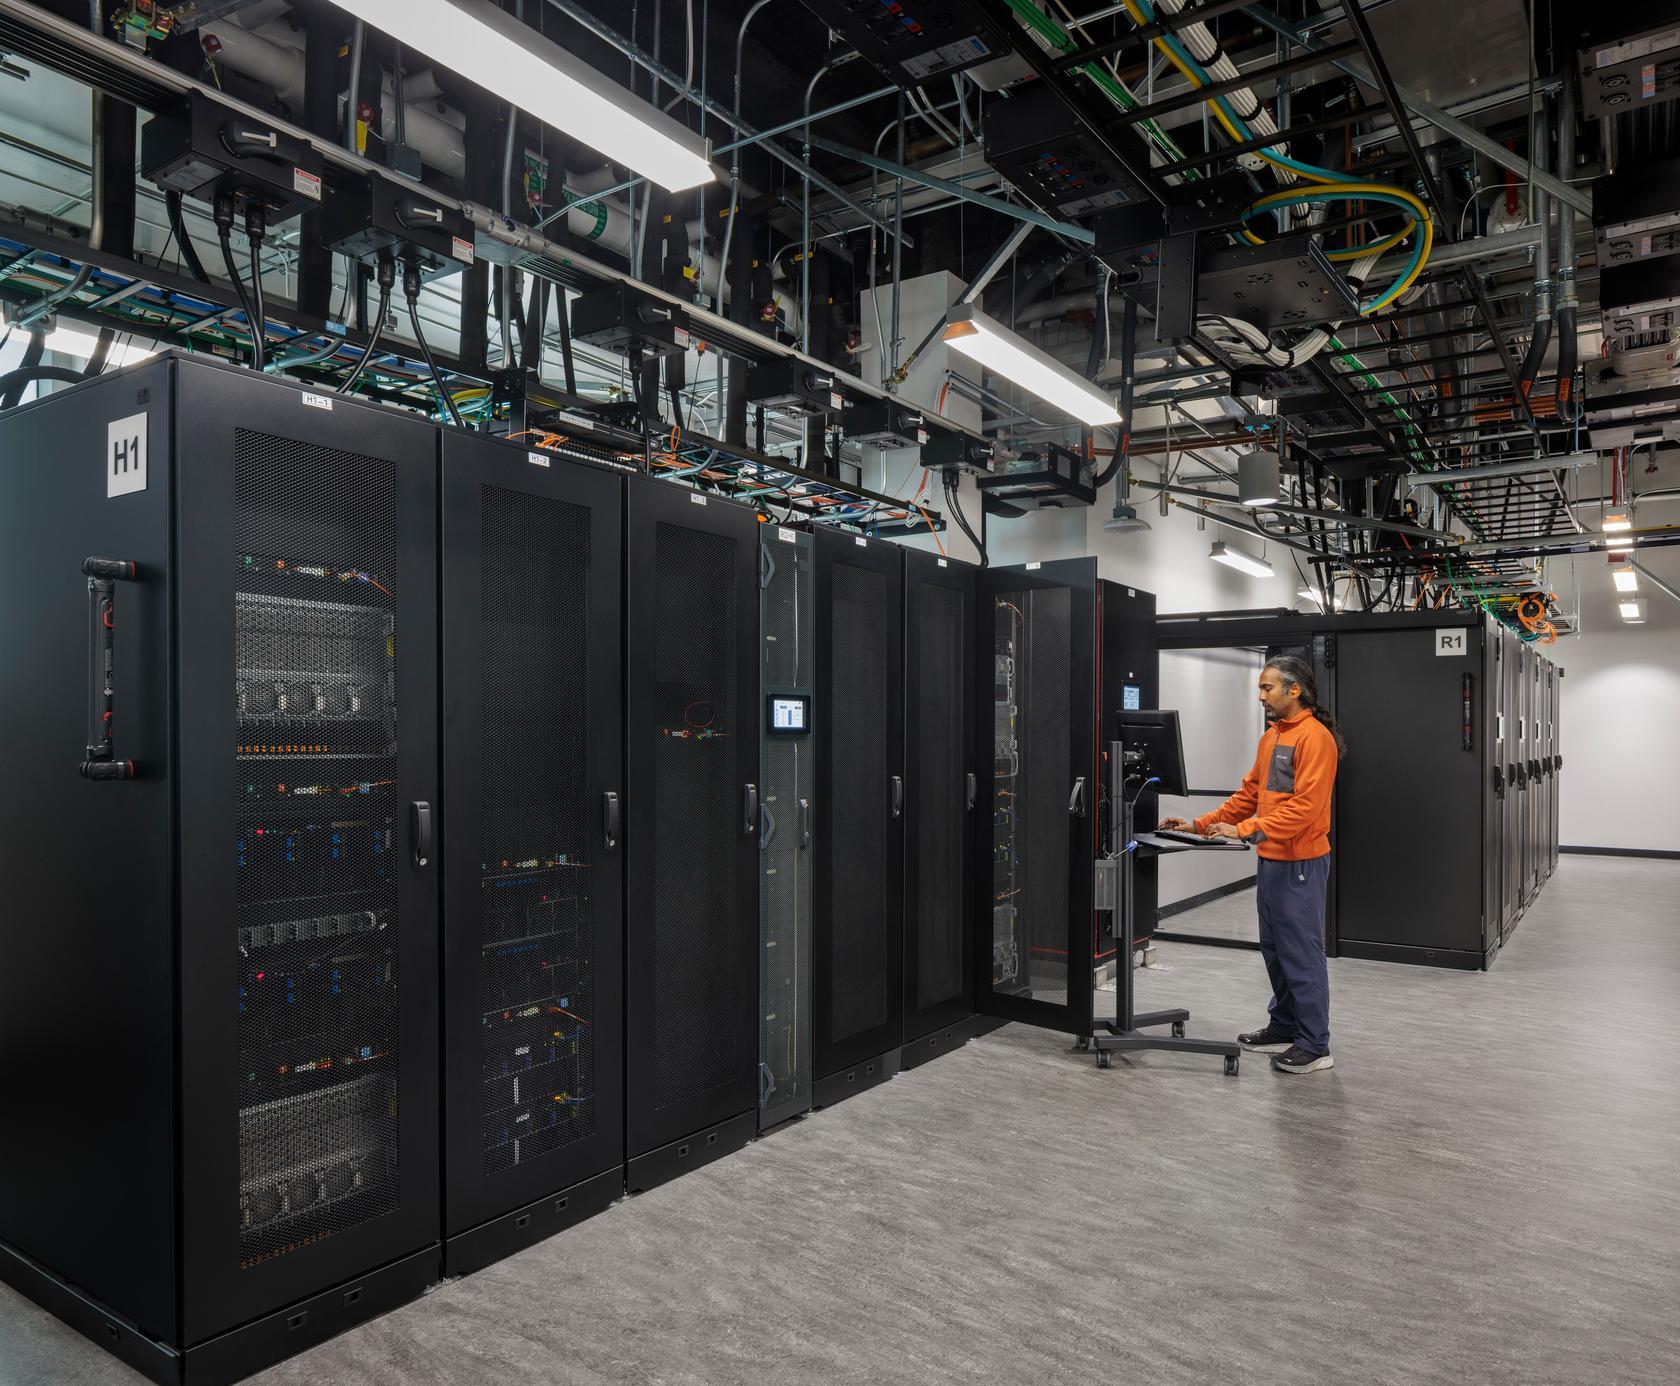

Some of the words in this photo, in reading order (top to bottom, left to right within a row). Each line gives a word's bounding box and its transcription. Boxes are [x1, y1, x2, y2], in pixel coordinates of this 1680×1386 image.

[306, 395, 328, 406] H1-1
[114, 435, 138, 475] H1
[1441, 636, 1461, 648] R1
